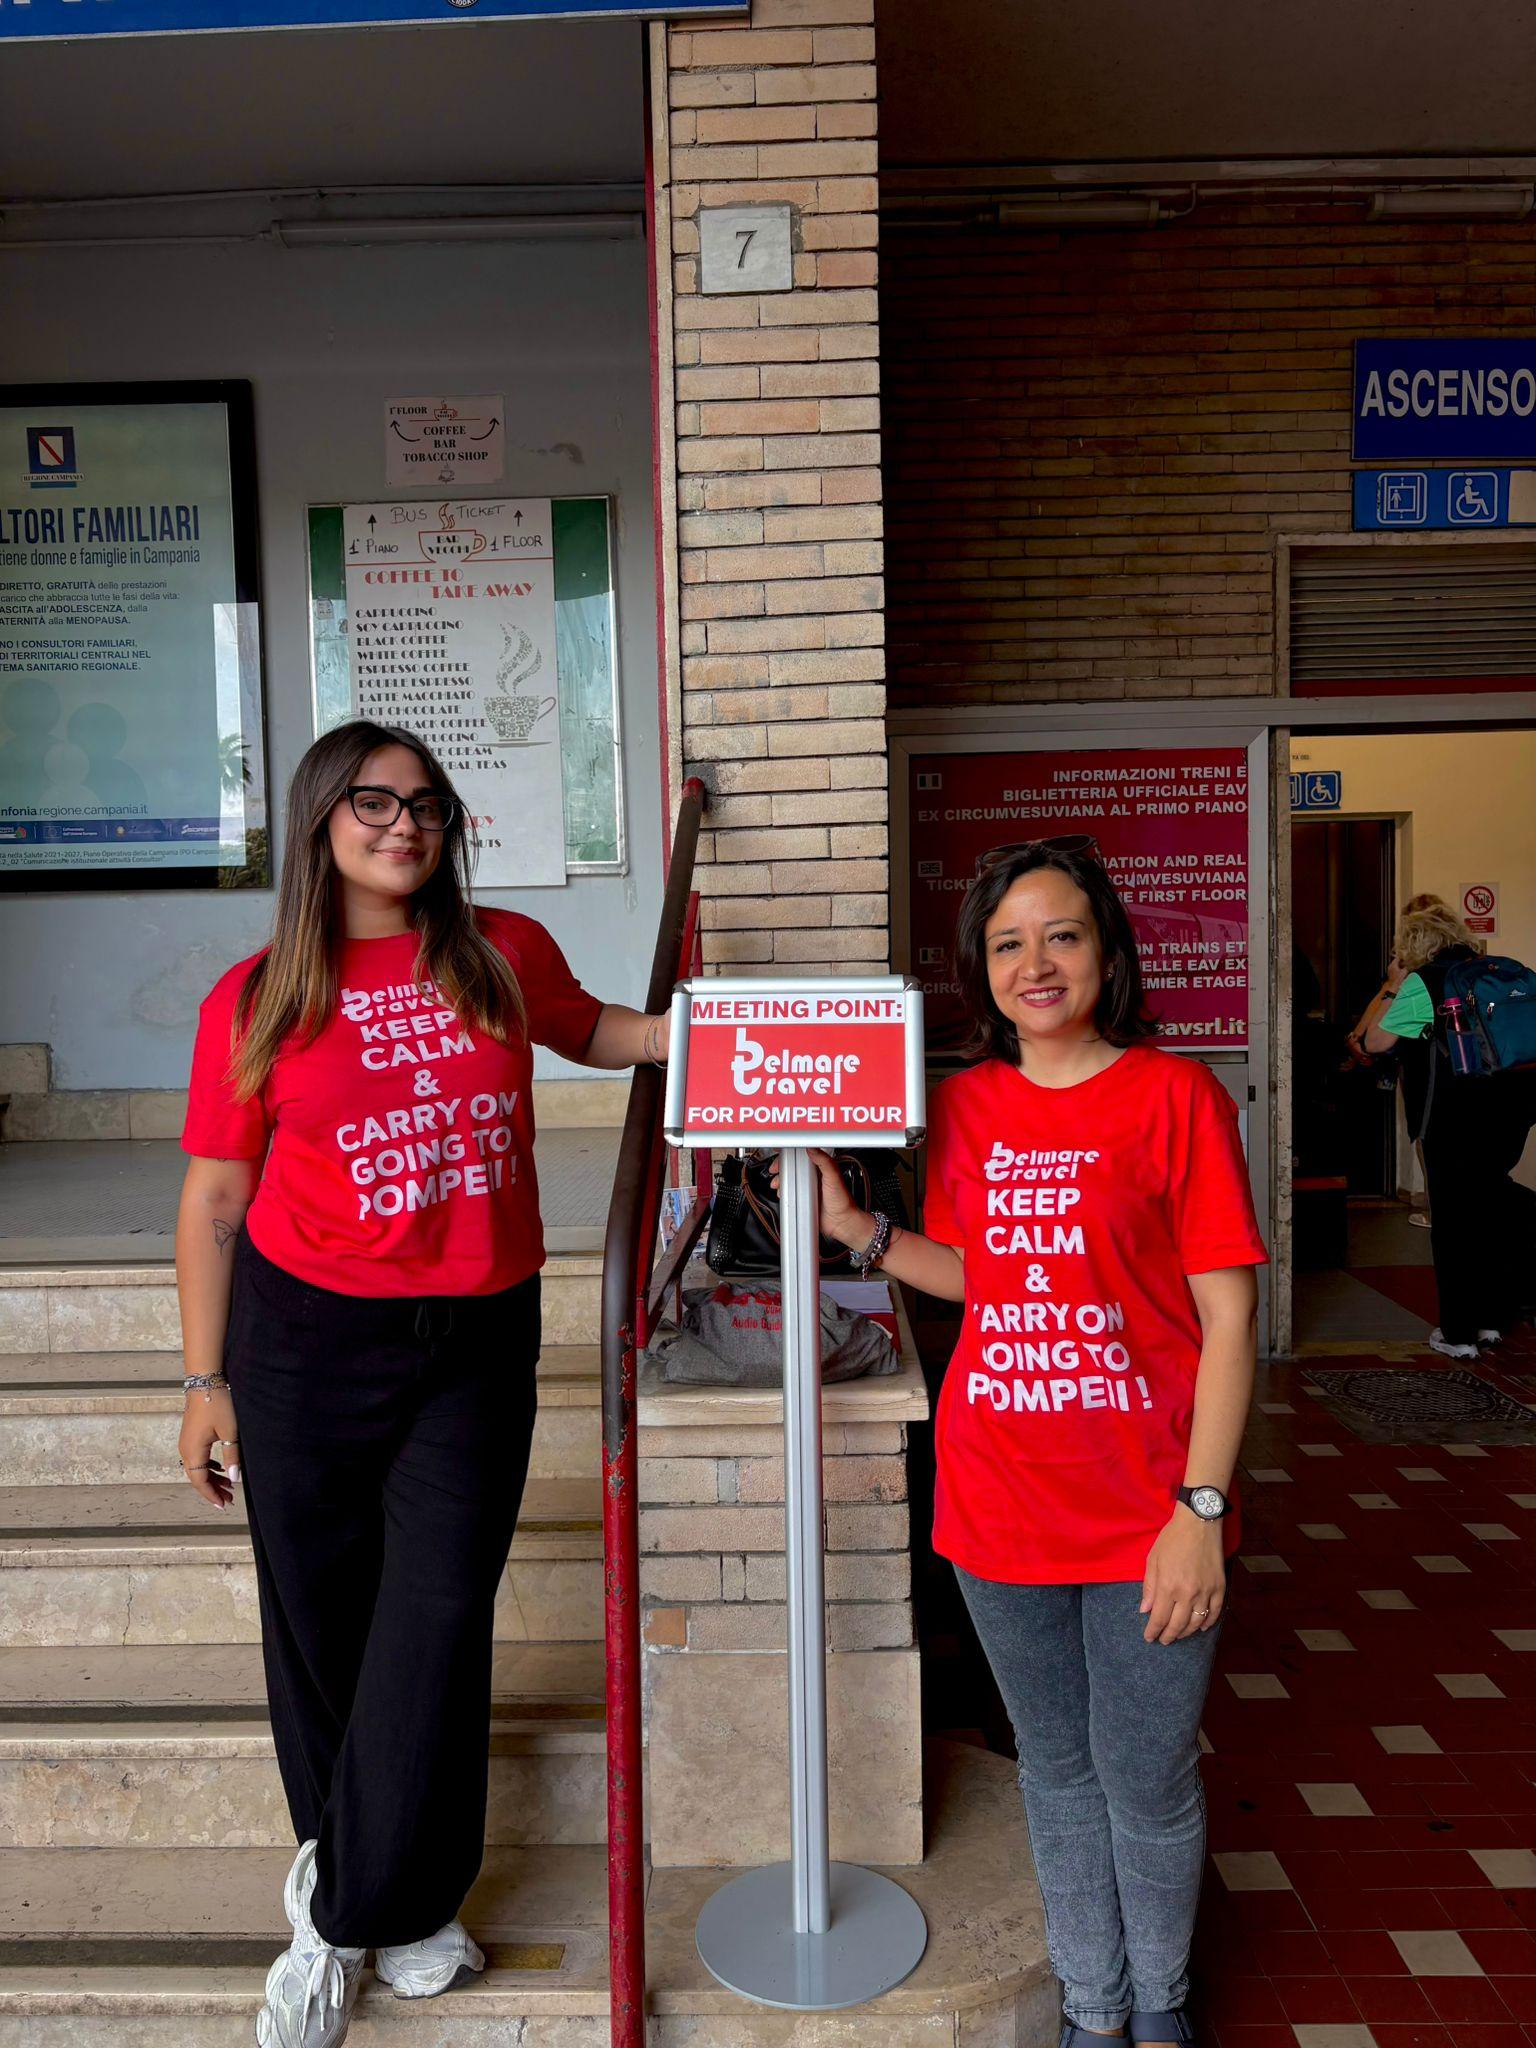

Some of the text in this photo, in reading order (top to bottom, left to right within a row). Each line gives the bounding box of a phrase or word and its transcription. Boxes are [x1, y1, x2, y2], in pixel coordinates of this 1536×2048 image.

[736, 230, 758, 269] 7
[1360, 368, 1536, 417] ASCENSO
[397, 407, 427, 415] FLOOR
[423, 425, 466, 435] COFFEE
[434, 439, 456, 448] BAR
[403, 452, 488, 462] TOBACCO SHOP
[391, 504, 505, 524] BUS TICKET
[73, 505, 200, 543] FAMILIARI
[503, 535, 543, 550] FLOOR
[31, 548, 67, 566] donne
[70, 554, 77, 565] e
[80, 547, 127, 568] famiglie
[130, 548, 140, 564] in
[144, 545, 200, 567] Campania
[365, 568, 464, 585] COFFEE TO
[47, 580, 95, 591] GRATUITÀ
[121, 581, 167, 592] prestazioni
[431, 582, 535, 599] TAKE AWAY
[29, 593, 44, 602] che
[47, 593, 88, 602] abbraccia
[91, 593, 110, 602] tutte
[113, 593, 120, 601] le
[123, 592, 137, 601] fasi
[140, 592, 160, 601] della
[128, 604, 148, 613] dalla
[355, 606, 437, 619] CAPPUCCINO
[48, 617, 63, 625] alla
[66, 616, 131, 625] MENOPAUSA.
[356, 620, 464, 633] SOY CAPPUCCINO
[22, 640, 85, 649] CONSULTORI
[356, 635, 448, 647] BLACK COFFEE
[11, 652, 78, 661] TERRITORIALI
[81, 651, 129, 660] CENTRALI
[132, 650, 151, 660] NEL
[357, 649, 448, 661] WHITE COFFEE
[26, 663, 78, 672] SANITARIO
[81, 662, 141, 671] REGIONALE.
[358, 662, 471, 675] ESPRESSO COFFEE
[359, 676, 473, 689] DOUBLE ESPRESSO
[359, 690, 475, 703] LATTE MACCHIATO
[360, 704, 462, 717] HOT CHOCOLATE
[441, 717, 488, 729] COFFEE
[420, 732, 479, 743] PUCCINO
[448, 746, 492, 757] CREAM
[476, 760, 507, 770] TEAS
[1053, 766, 1247, 783] INFORMAZIONI TRENI E
[1003, 783, 1247, 802] BIGLIETTERIA UFFICIALE EAV
[918, 801, 1247, 822] EX CIRCUMVESUVIANA AL PRIMO PIANO
[1164, 855, 1198, 868] AND
[1203, 854, 1246, 866] REAL
[1108, 872, 1246, 887] CUMVESUVIANA
[1139, 889, 1186, 903] FIRST
[1192, 888, 1246, 902] FLOOR
[1159, 942, 1219, 955] TRAINS
[1225, 941, 1246, 953] ET
[1140, 958, 1247, 972] ELLE EAV EX
[1193, 976, 1246, 989] ETAGE
[692, 999, 902, 1019] MEETING POINT:
[360, 1011, 456, 1042] KEEP
[361, 1032, 476, 1071] CALM
[413, 1069, 441, 1097] &
[337, 1091, 517, 1152] CARRY ON
[688, 1106, 902, 1123] FOR POMPEII TOUR
[351, 1125, 511, 1185] GOING TO
[987, 1188, 1081, 1216] KEEP
[985, 1225, 1086, 1255] CALM
[1025, 1263, 1051, 1293] &
[974, 1302, 1124, 1335] ARRY ON
[982, 1340, 1131, 1372] OING TO
[967, 1372, 1129, 1412] POMPEII
